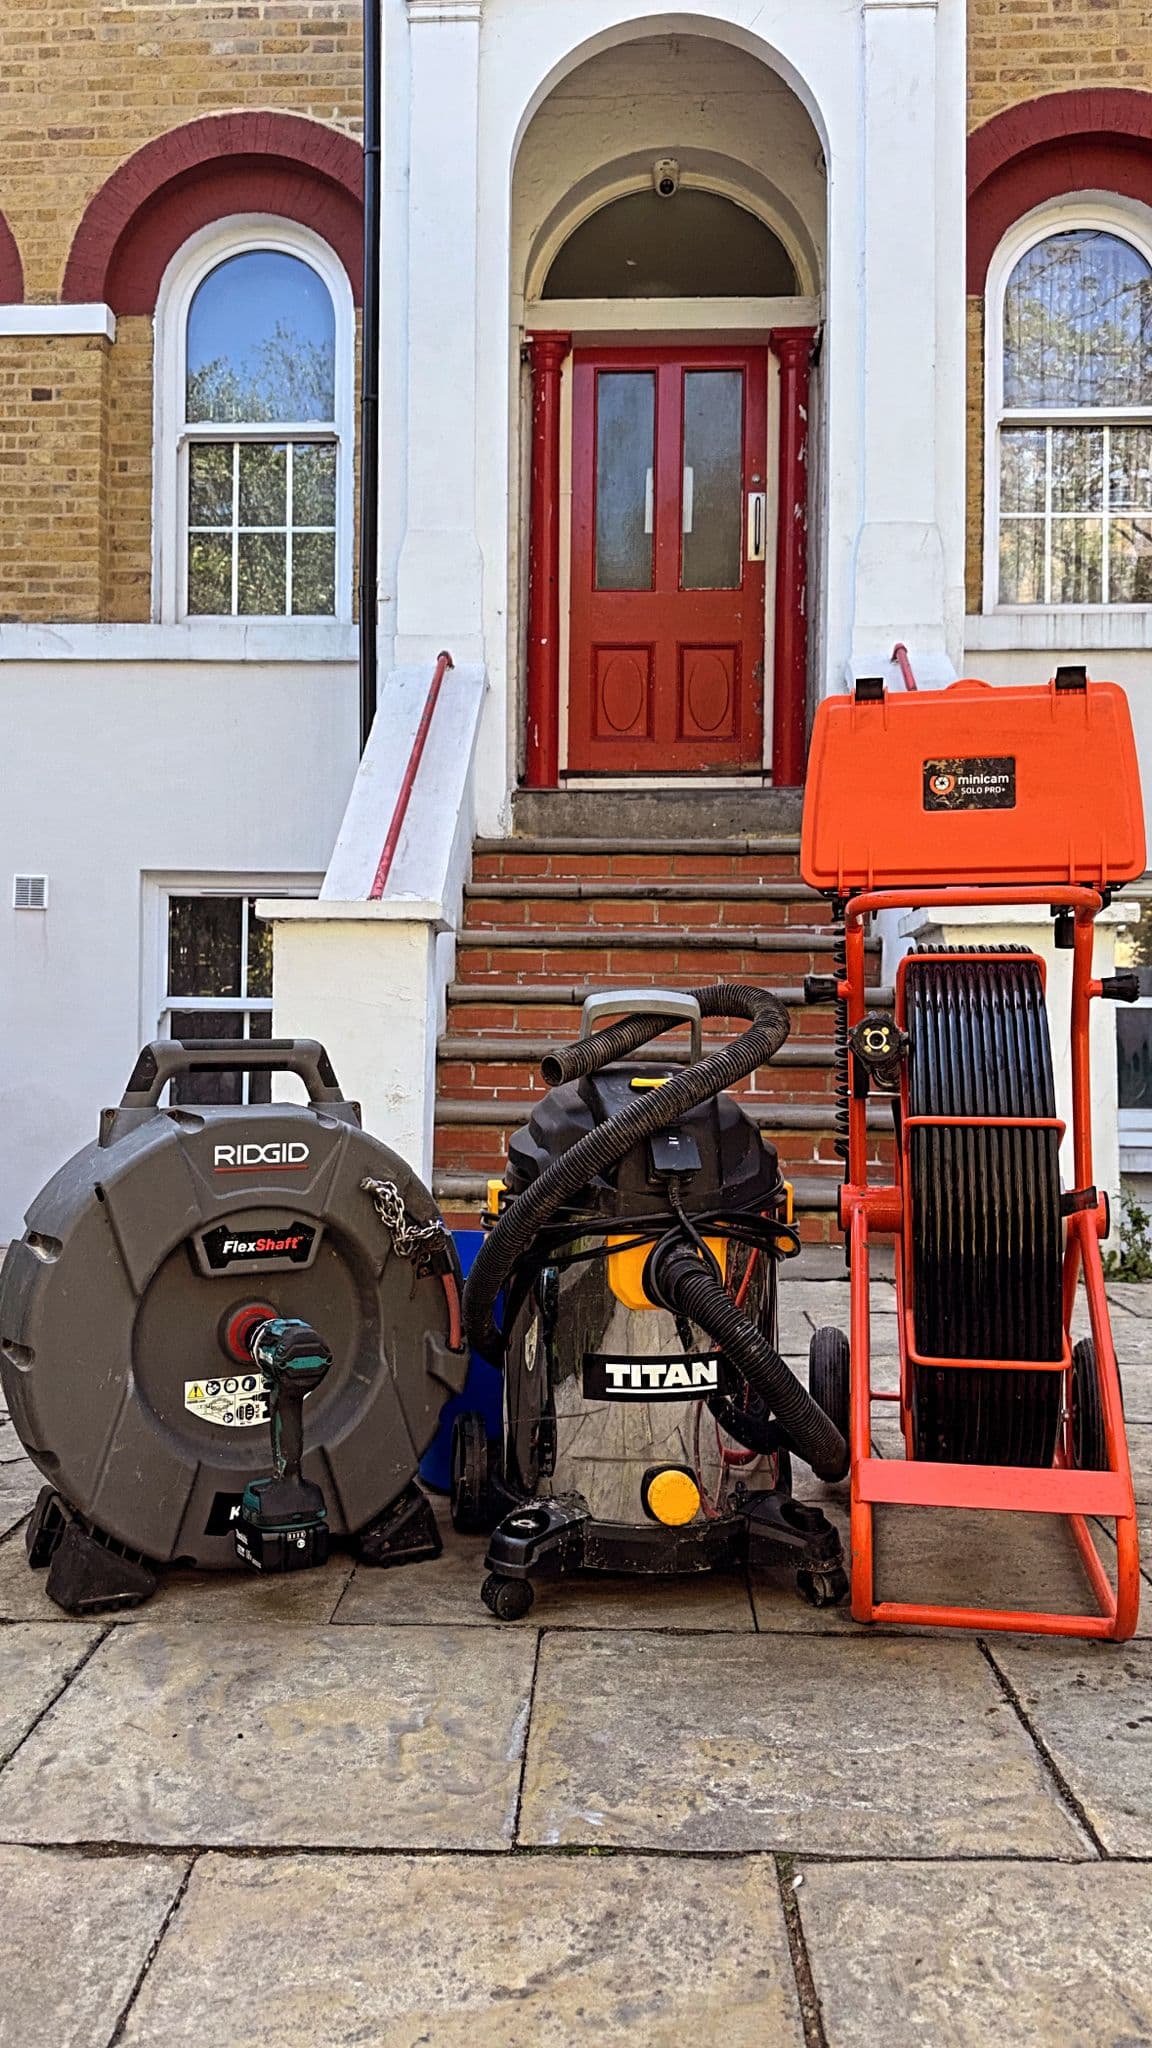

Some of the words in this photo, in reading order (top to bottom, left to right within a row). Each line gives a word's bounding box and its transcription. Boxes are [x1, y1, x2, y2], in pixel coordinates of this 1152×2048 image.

[957, 773, 1009, 785] minicam
[961, 786, 983, 795] SOLO
[214, 1142, 310, 1166] RIDGID
[605, 1360, 718, 1388] TITAN
